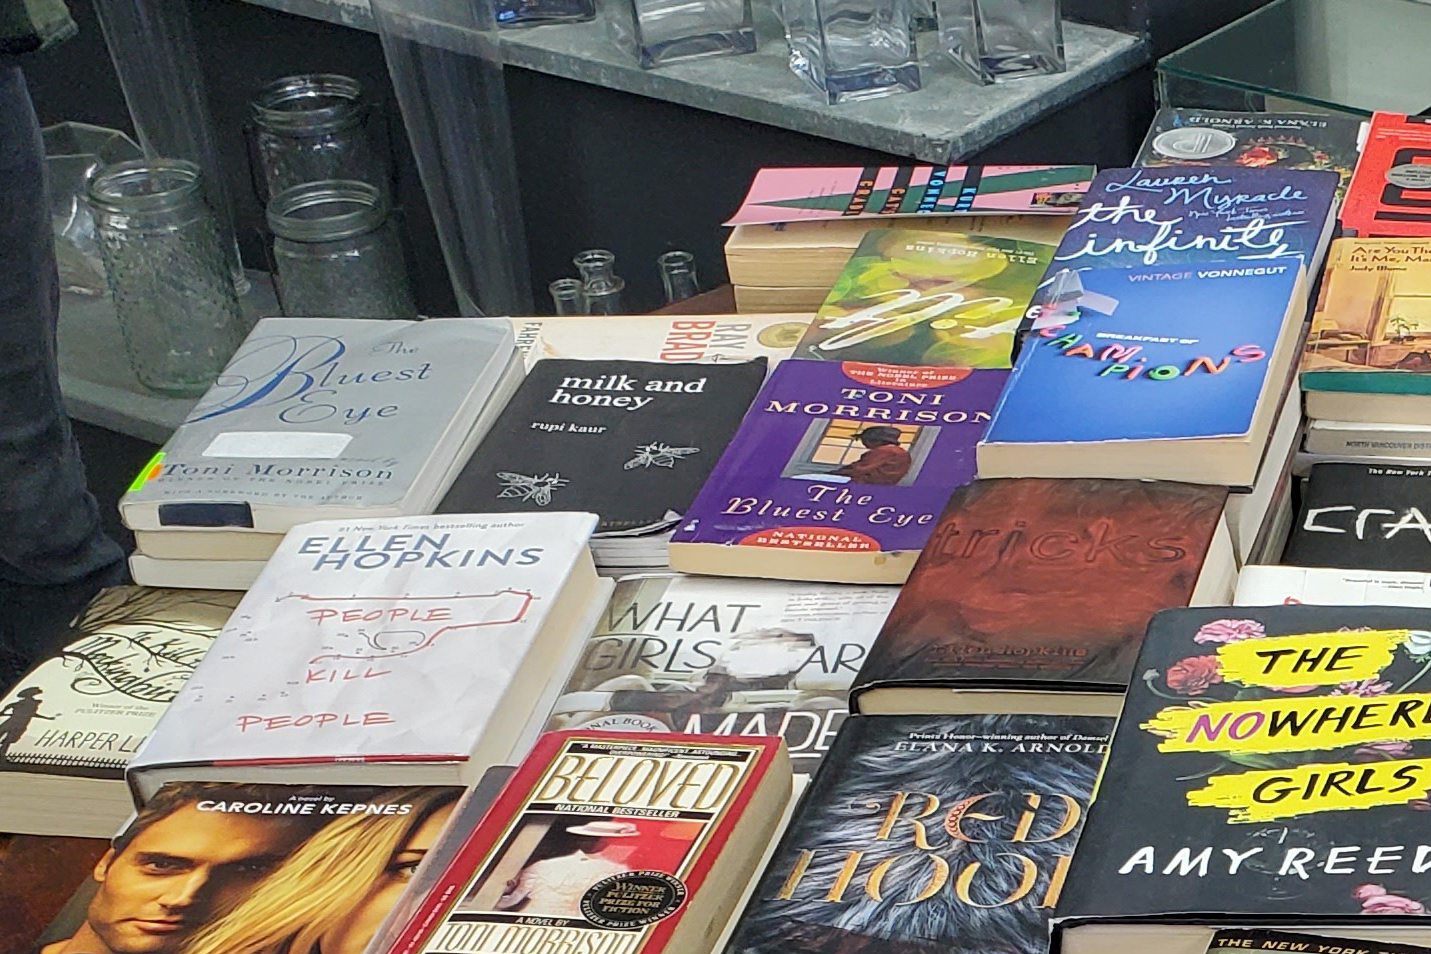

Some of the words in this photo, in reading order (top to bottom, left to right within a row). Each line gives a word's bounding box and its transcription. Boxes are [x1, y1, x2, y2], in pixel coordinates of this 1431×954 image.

[1163, 186, 1308, 212] Myracle
[1068, 196, 1183, 231] the
[1054, 218, 1308, 266] infinite
[1352, 246, 1381, 255] Are
[1383, 246, 1409, 255] You
[1128, 271, 1192, 282] VINTAGE
[1197, 266, 1287, 279] VONNEGUT
[559, 374, 638, 393] milk
[645, 377, 707, 394] and
[279, 390, 399, 425] Eye
[548, 389, 653, 411] honey
[840, 388, 946, 406] TONI
[531, 421, 566, 433] rupi
[568, 423, 607, 434] kaur
[162, 463, 234, 478] Toni
[250, 464, 394, 480] Morrison
[807, 484, 873, 506] The
[721, 497, 844, 522] Bluest
[868, 506, 934, 527] Eye
[297, 534, 452, 554] ELLEN
[934, 518, 1187, 565] tricks
[312, 548, 544, 571] HOPKINS
[307, 608, 453, 624] PEOPLE
[607, 602, 761, 633] WHAT
[582, 637, 722, 673] GIRLS
[1256, 645, 1369, 676] THE
[305, 669, 392, 684] KILL
[236, 712, 395, 732] PEOPLE
[34, 729, 118, 750] HARPER
[538, 755, 741, 810] BELOVED
[1251, 765, 1425, 804] GIRLS
[196, 800, 319, 816] CAROLINE
[323, 803, 413, 815] KEPNES
[1118, 846, 1264, 877] AMY
[441, 923, 492, 952] TONI
[1218, 938, 1254, 949] THE
[1262, 940, 1310, 952] NEW
